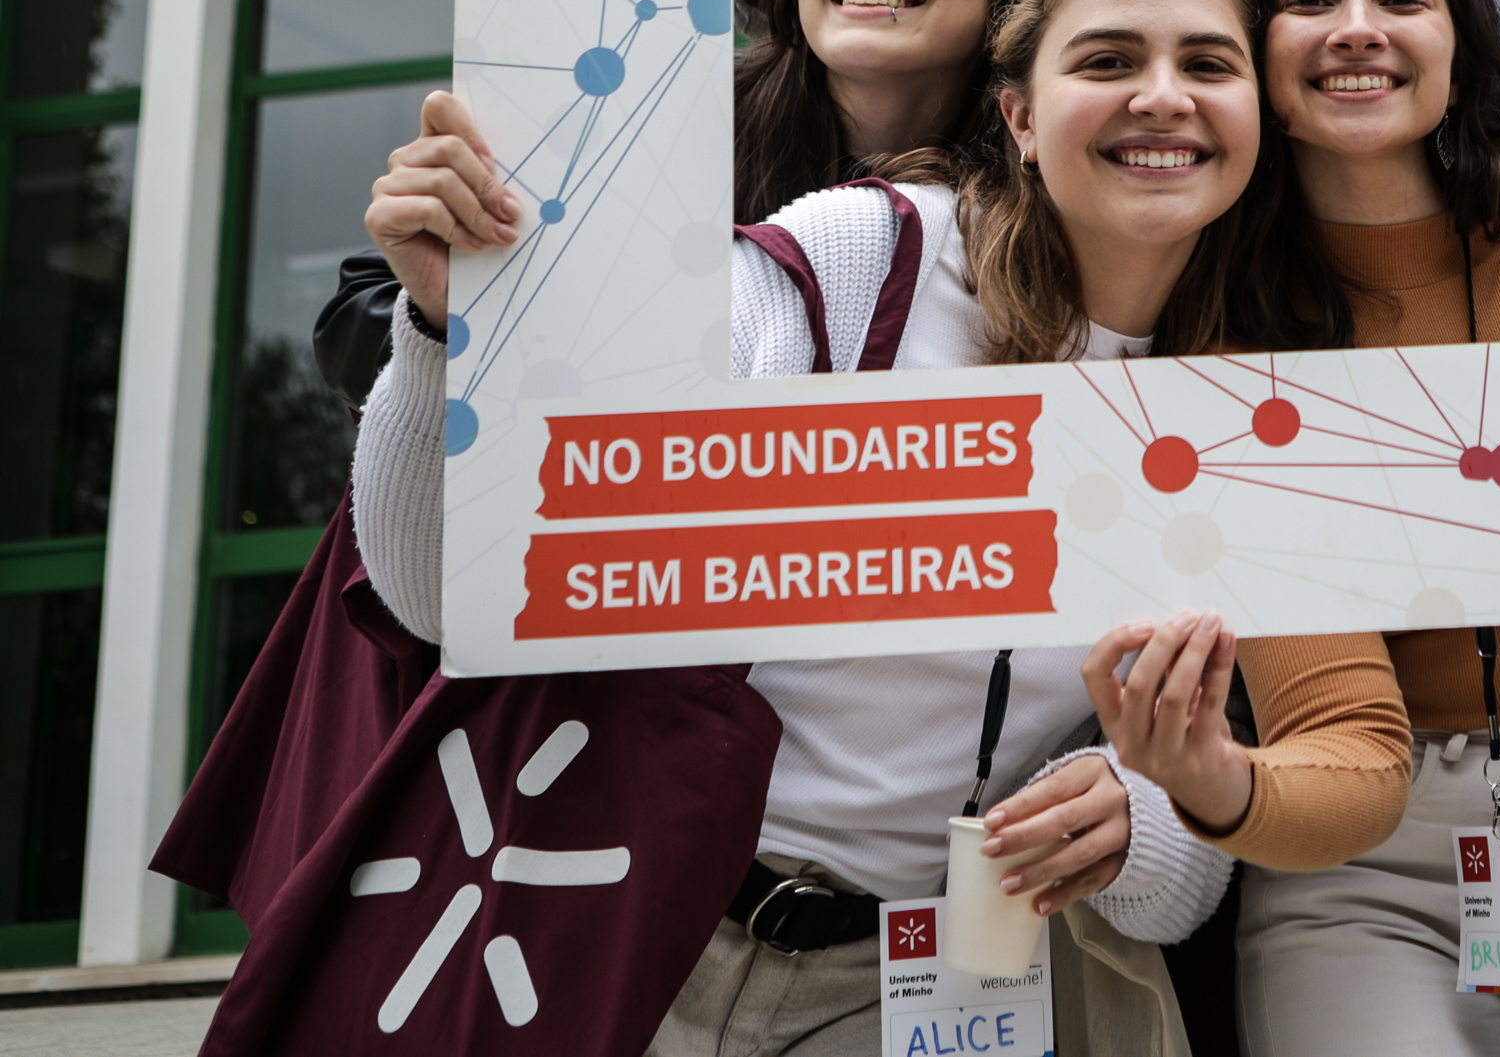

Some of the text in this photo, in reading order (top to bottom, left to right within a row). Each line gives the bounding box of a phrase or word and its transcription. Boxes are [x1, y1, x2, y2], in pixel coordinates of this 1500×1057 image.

[563, 420, 1018, 486] NO BOUNDARIES
[564, 542, 1015, 611] SEM BARREIRAS
[1464, 896, 1493, 907] University
[1465, 908, 1491, 918] of Minho
[889, 972, 938, 985] University
[889, 986, 933, 999] of Minho
